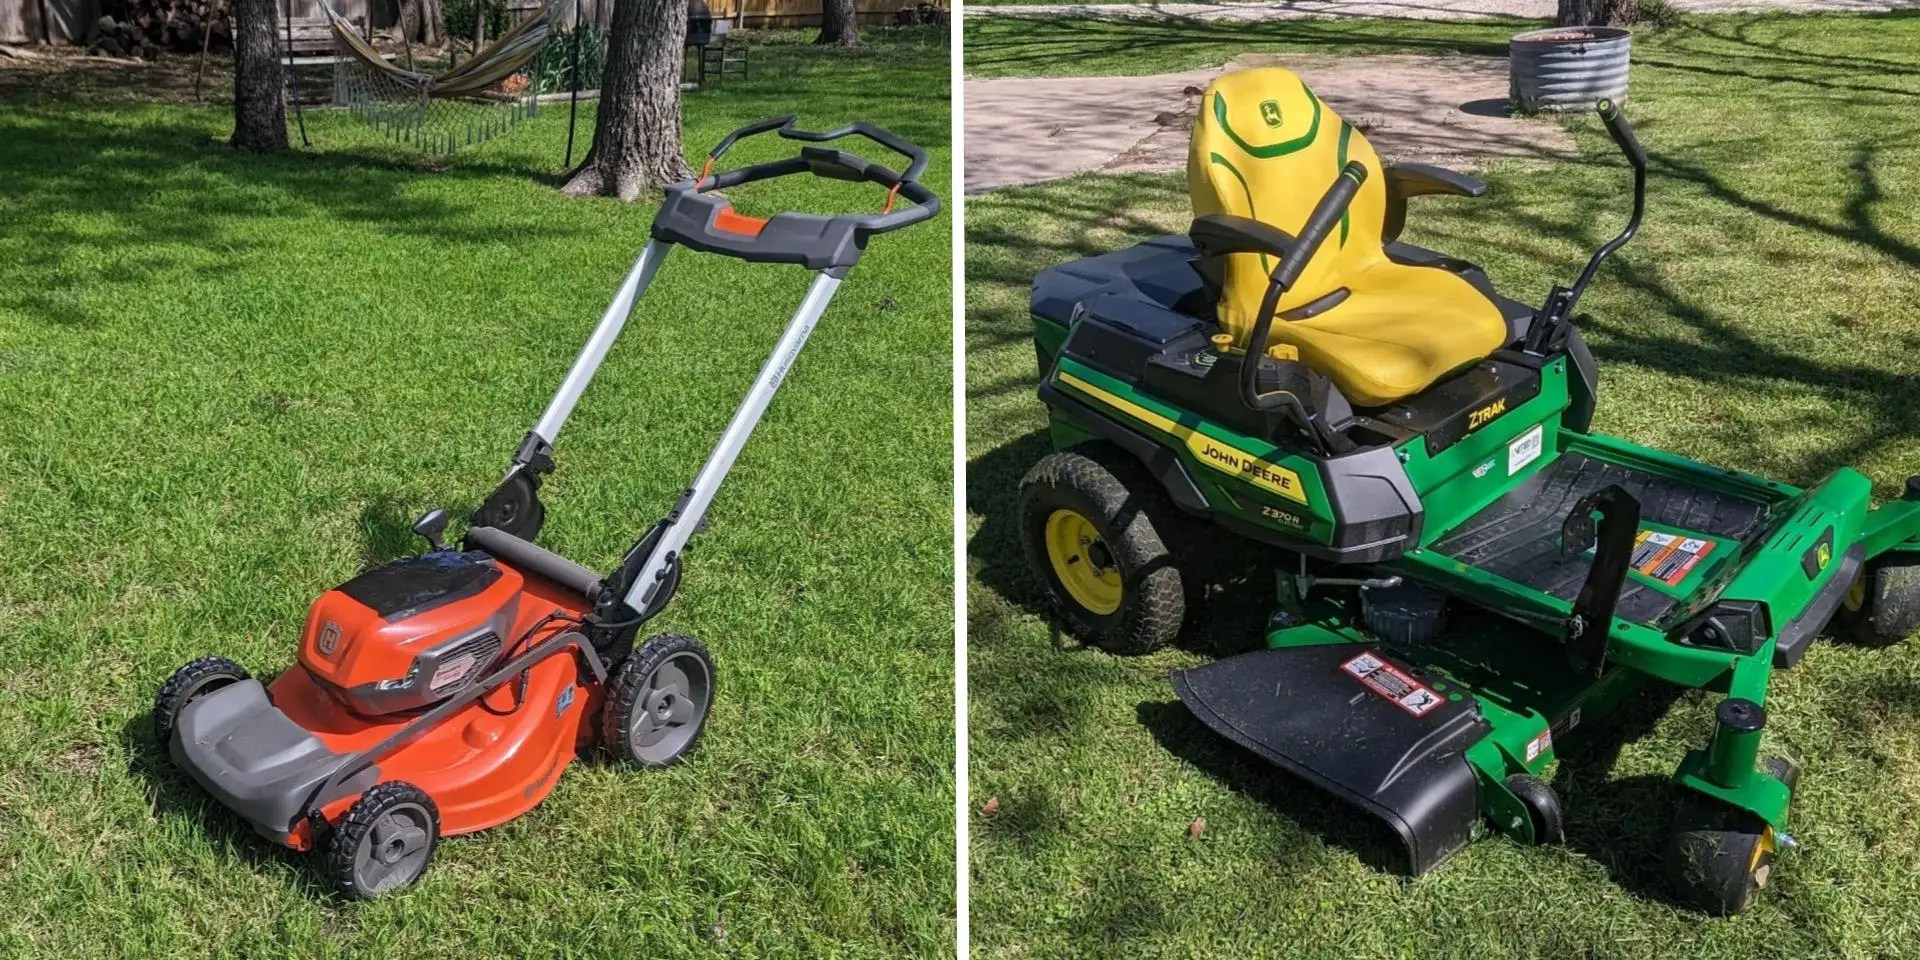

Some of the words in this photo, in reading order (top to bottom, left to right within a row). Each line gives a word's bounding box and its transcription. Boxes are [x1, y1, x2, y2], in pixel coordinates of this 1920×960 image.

[1468, 397, 1506, 430] ZTRAK
[1202, 444, 1238, 468] JOHN
[1242, 459, 1291, 489] DEERE
